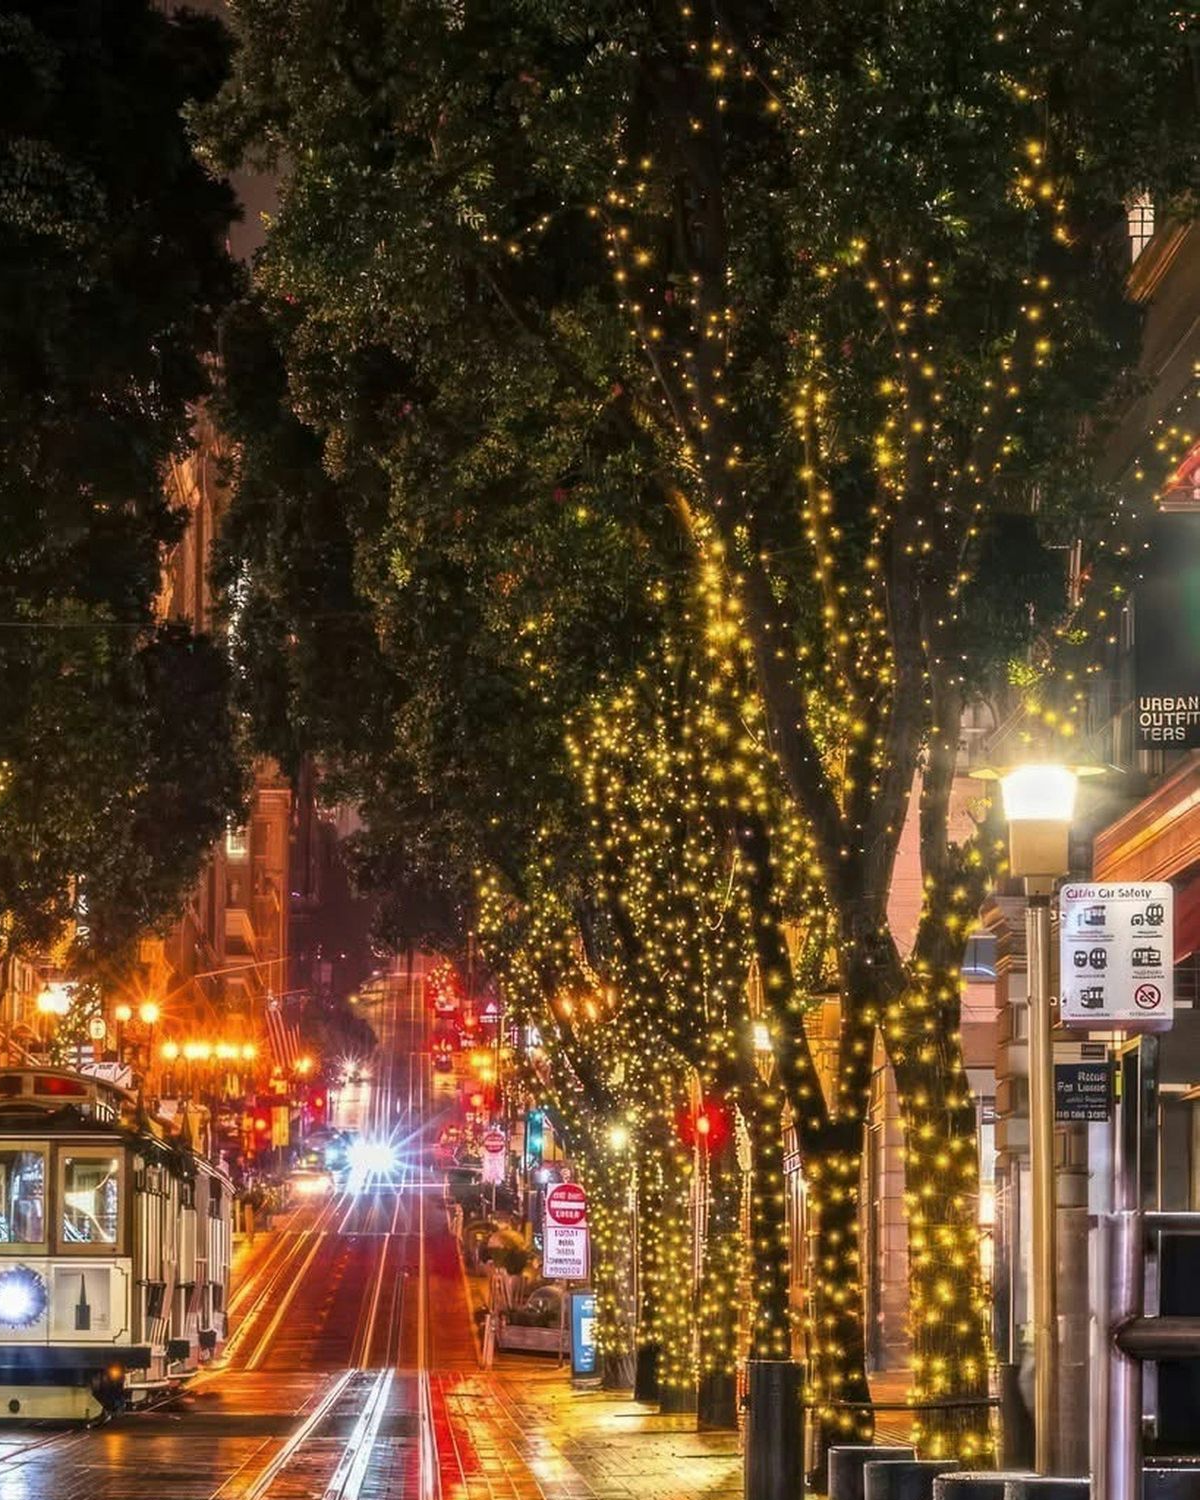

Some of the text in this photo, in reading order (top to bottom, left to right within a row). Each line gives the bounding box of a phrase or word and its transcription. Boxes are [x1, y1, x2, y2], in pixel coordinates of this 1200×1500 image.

[1140, 696, 1199, 711] URBAN
[1140, 711, 1200, 727] OUTFIT
[1140, 726, 1185, 741] TERS
